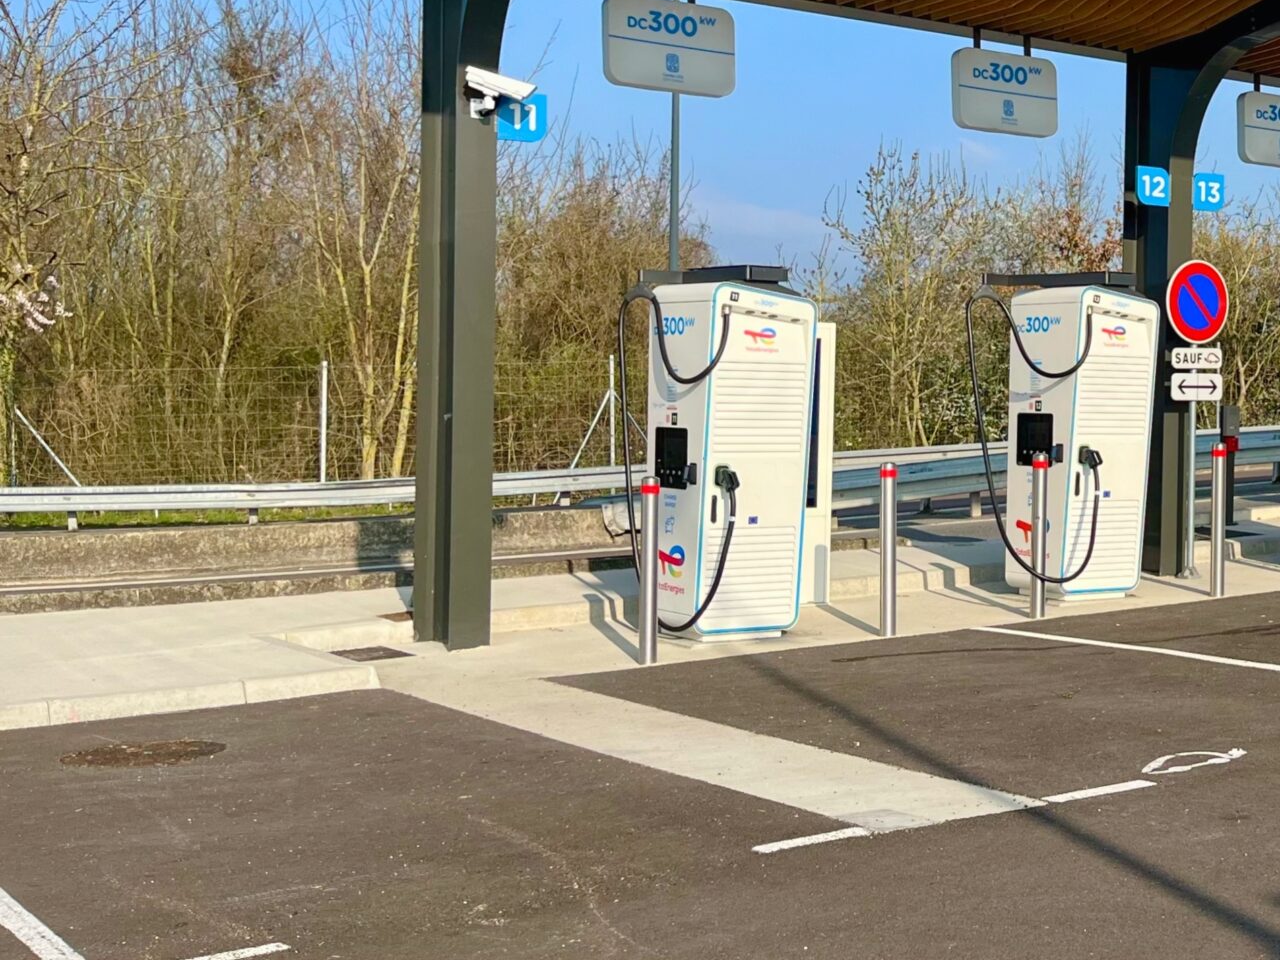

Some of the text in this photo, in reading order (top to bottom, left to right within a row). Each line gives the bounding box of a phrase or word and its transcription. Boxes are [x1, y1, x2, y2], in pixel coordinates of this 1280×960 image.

[508, 103, 537, 132] 11
[1142, 174, 1166, 198] 12
[1198, 181, 1220, 203] 13
[1175, 352, 1203, 364] SAUF
